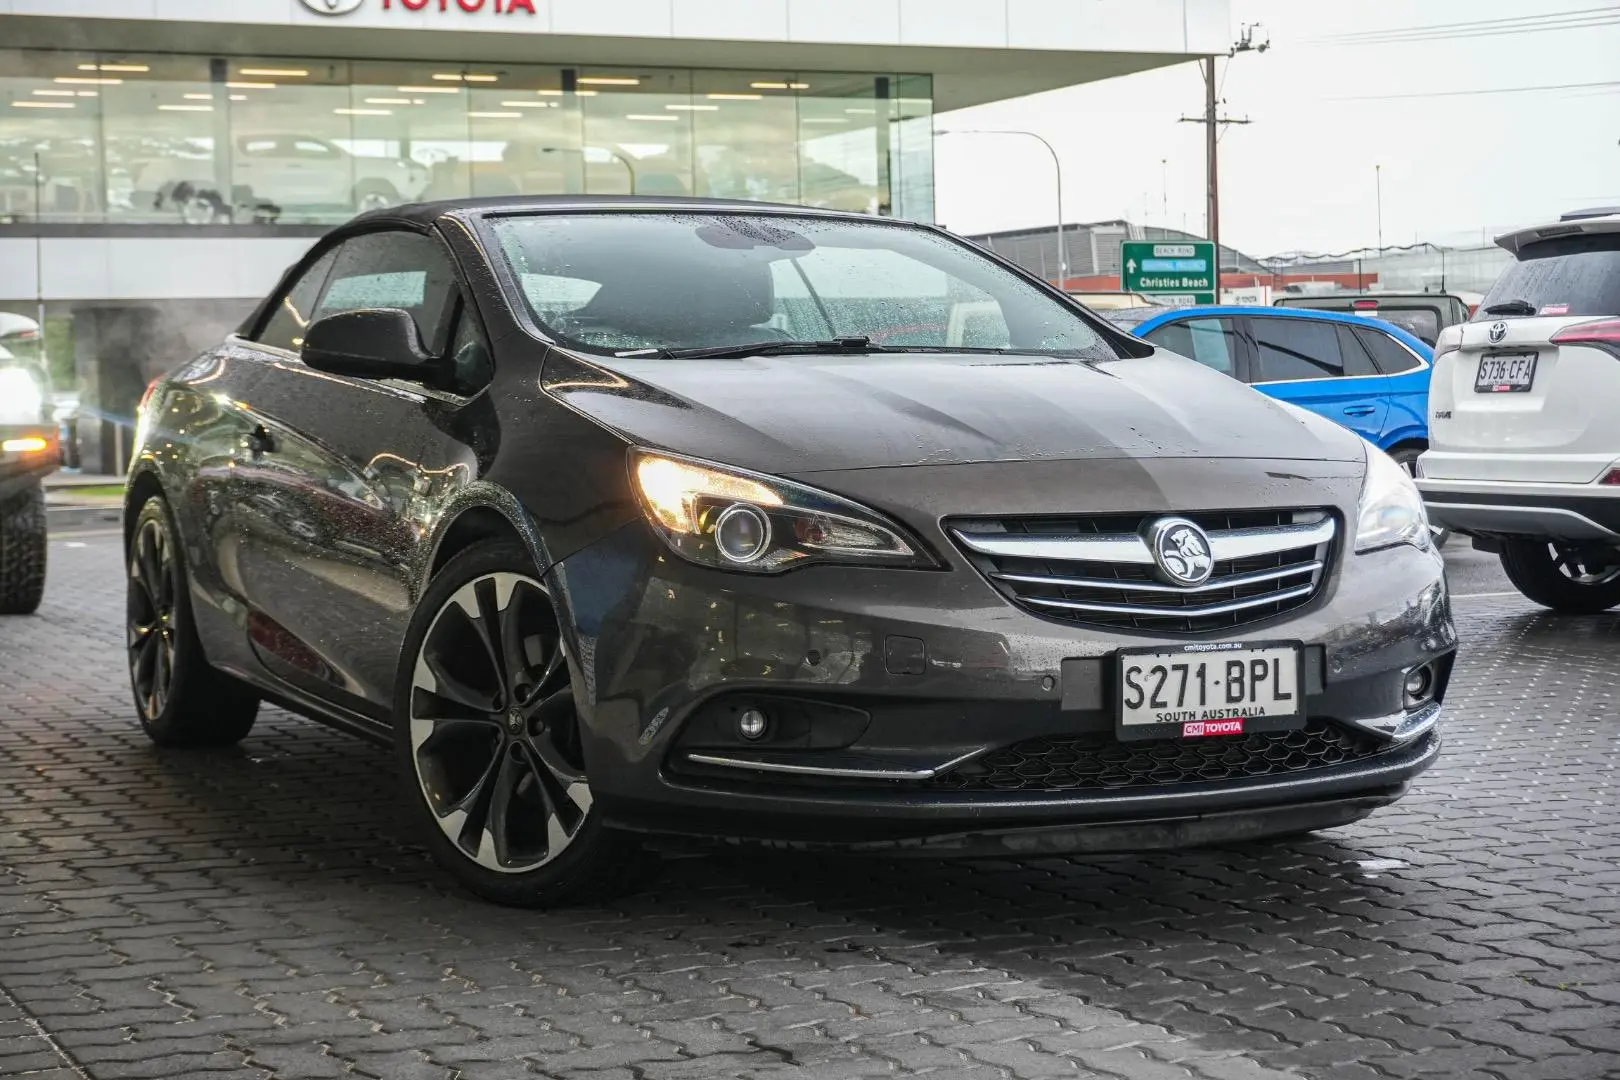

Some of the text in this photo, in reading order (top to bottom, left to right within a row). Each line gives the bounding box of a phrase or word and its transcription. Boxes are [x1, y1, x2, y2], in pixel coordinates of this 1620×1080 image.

[1140, 277, 1208, 287] Christies Beach
[1184, 643, 1242, 652] cmitoyota.com.au
[1156, 706, 1266, 722] SOUTH AUSTRALIA
[1185, 721, 1242, 735] CMI TOYOTA
